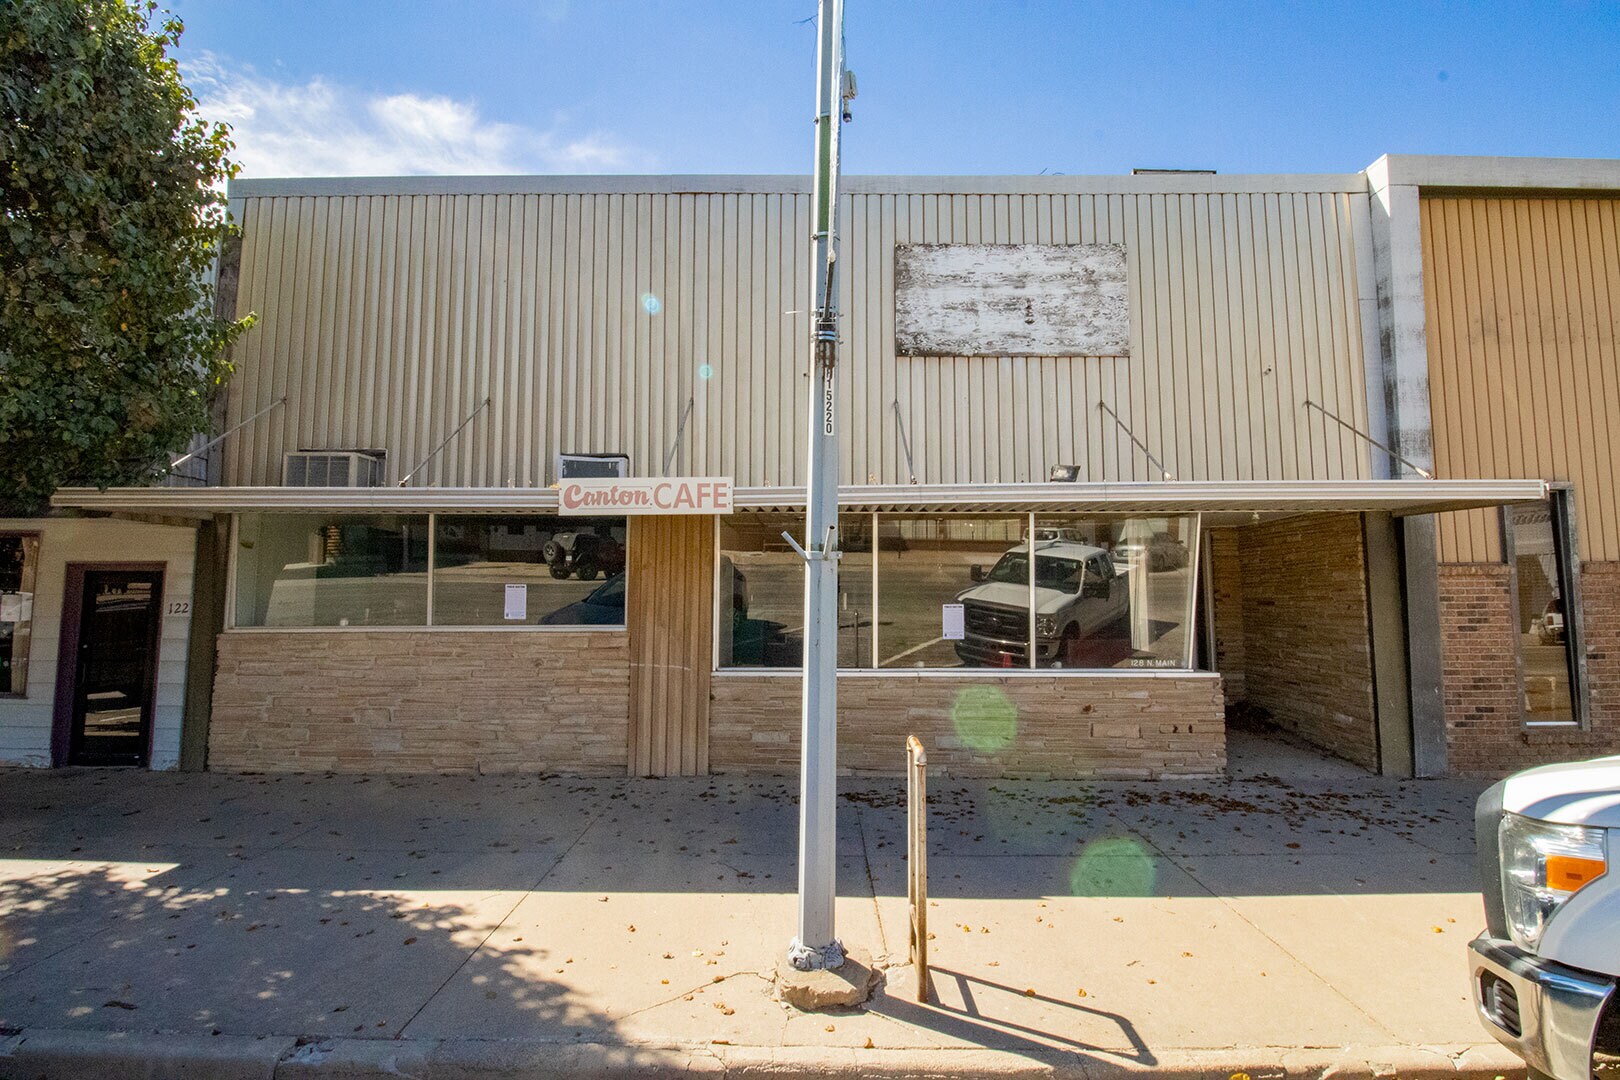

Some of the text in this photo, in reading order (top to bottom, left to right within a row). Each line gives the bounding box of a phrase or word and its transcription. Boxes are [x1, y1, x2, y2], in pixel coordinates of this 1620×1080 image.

[563, 483, 728, 509] Canton CAFE
[168, 602, 189, 615] 122
